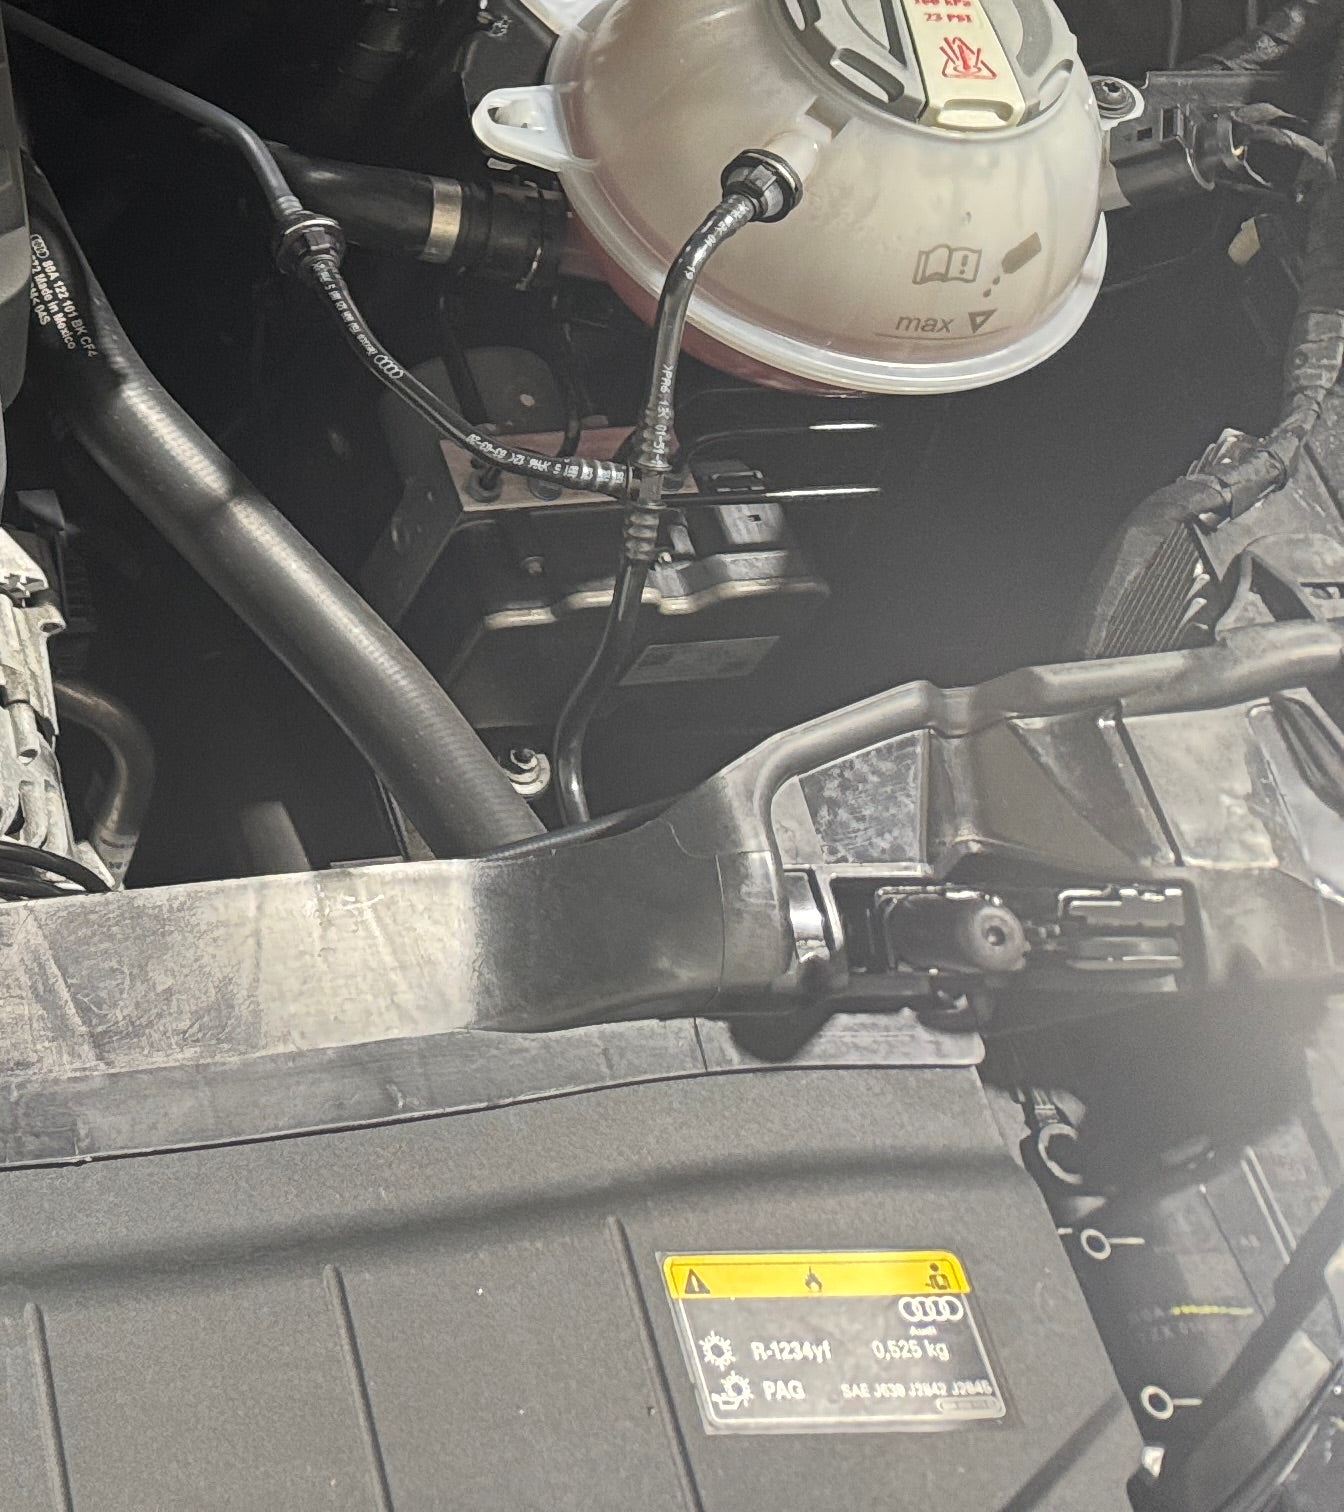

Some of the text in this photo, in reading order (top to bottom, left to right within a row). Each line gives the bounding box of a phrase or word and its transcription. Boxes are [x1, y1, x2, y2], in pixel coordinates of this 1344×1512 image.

[34, 273, 54, 302] Made
[47, 300, 59, 313] in
[53, 312, 76, 349] Mexico
[42, 260, 99, 357] 80A 122 101 BK CF4
[895, 316, 954, 333] max
[751, 1340, 950, 1364] R-1234yf 0,525 kg
[763, 1381, 806, 1400] PAG
[840, 1383, 871, 1398] SAE
